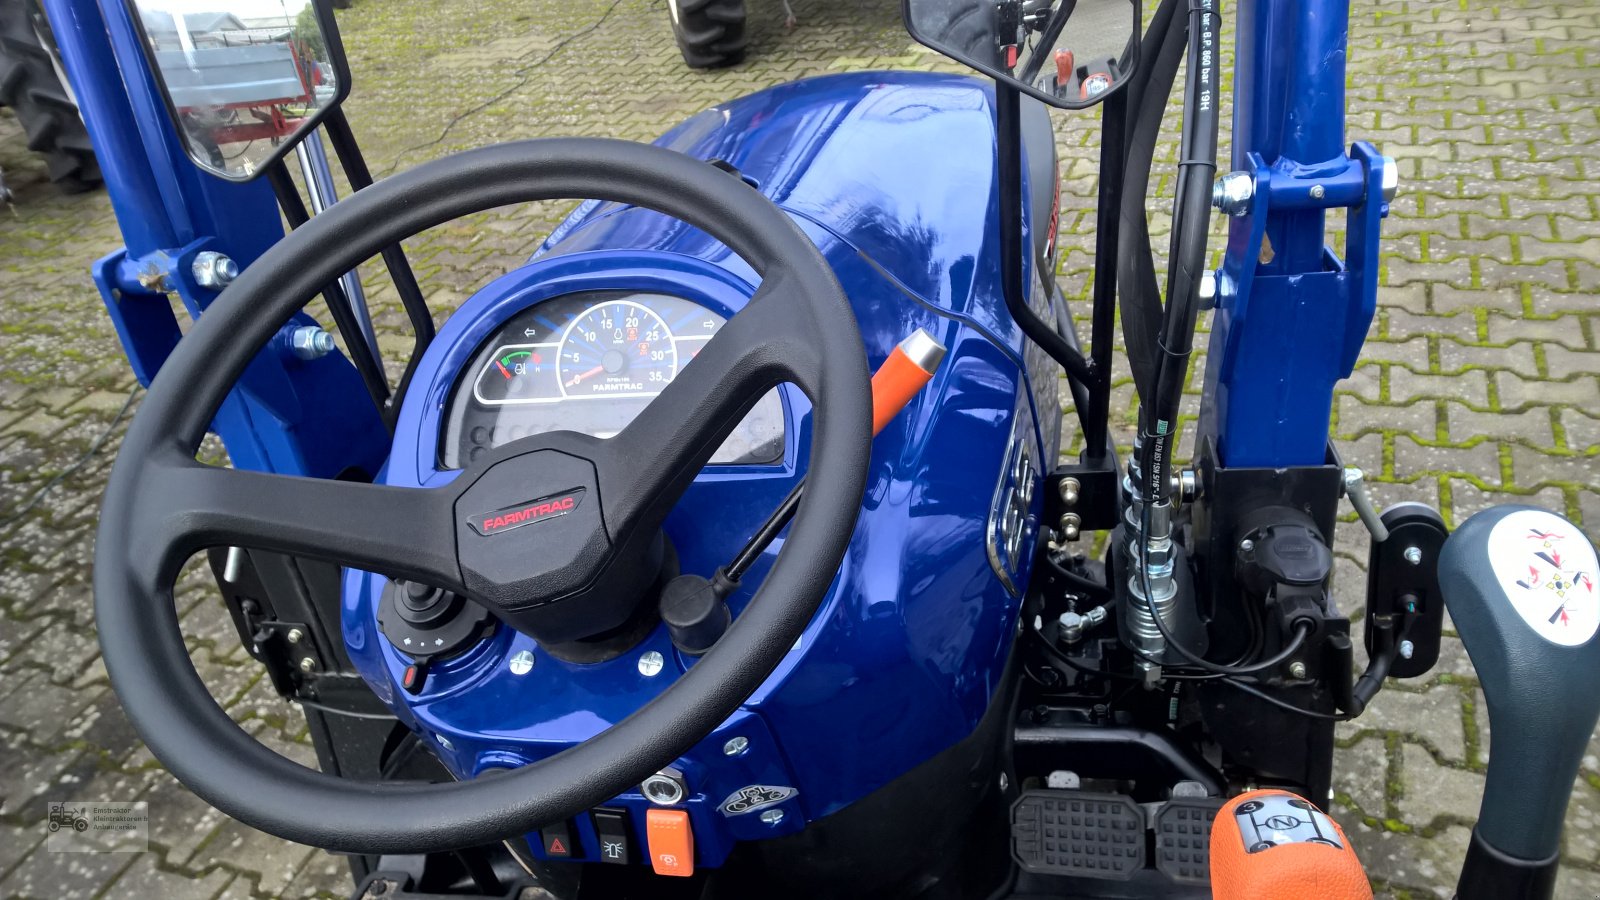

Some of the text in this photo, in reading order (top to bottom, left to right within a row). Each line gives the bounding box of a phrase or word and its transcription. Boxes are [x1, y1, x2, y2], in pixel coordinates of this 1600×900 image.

[1203, 12, 1211, 26] bar
[1203, 32, 1211, 48] B.P.
[1202, 50, 1211, 66] 860
[1201, 68, 1210, 84] bar
[1200, 90, 1210, 111] 19H
[601, 319, 613, 329] 15
[626, 318, 638, 328] 20
[584, 332, 596, 342] 10
[646, 331, 659, 341] 25
[573, 353, 580, 363] 5
[651, 351, 664, 361] 30
[573, 375, 580, 385] 0
[649, 371, 662, 382] 35
[593, 383, 643, 392] FARMTRAC
[1155, 444, 1163, 453] EN
[483, 497, 574, 531] FARMTRAC
[1243, 803, 1256, 812] 3
[1273, 816, 1294, 828] N
